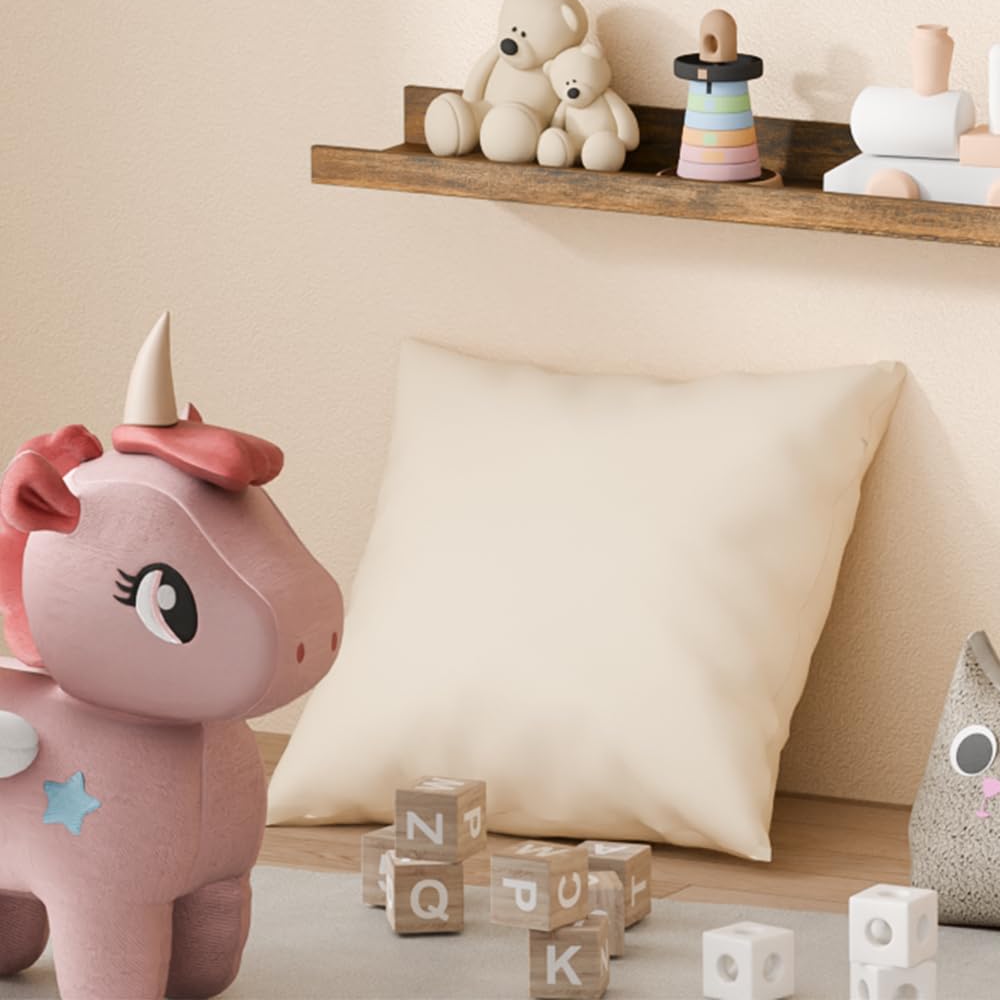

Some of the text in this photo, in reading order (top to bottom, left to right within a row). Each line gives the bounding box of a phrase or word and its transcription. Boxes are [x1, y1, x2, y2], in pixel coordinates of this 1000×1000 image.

[464, 806, 481, 839] P
[410, 879, 449, 921] Q
[502, 877, 537, 912] P
[546, 944, 583, 986] K
